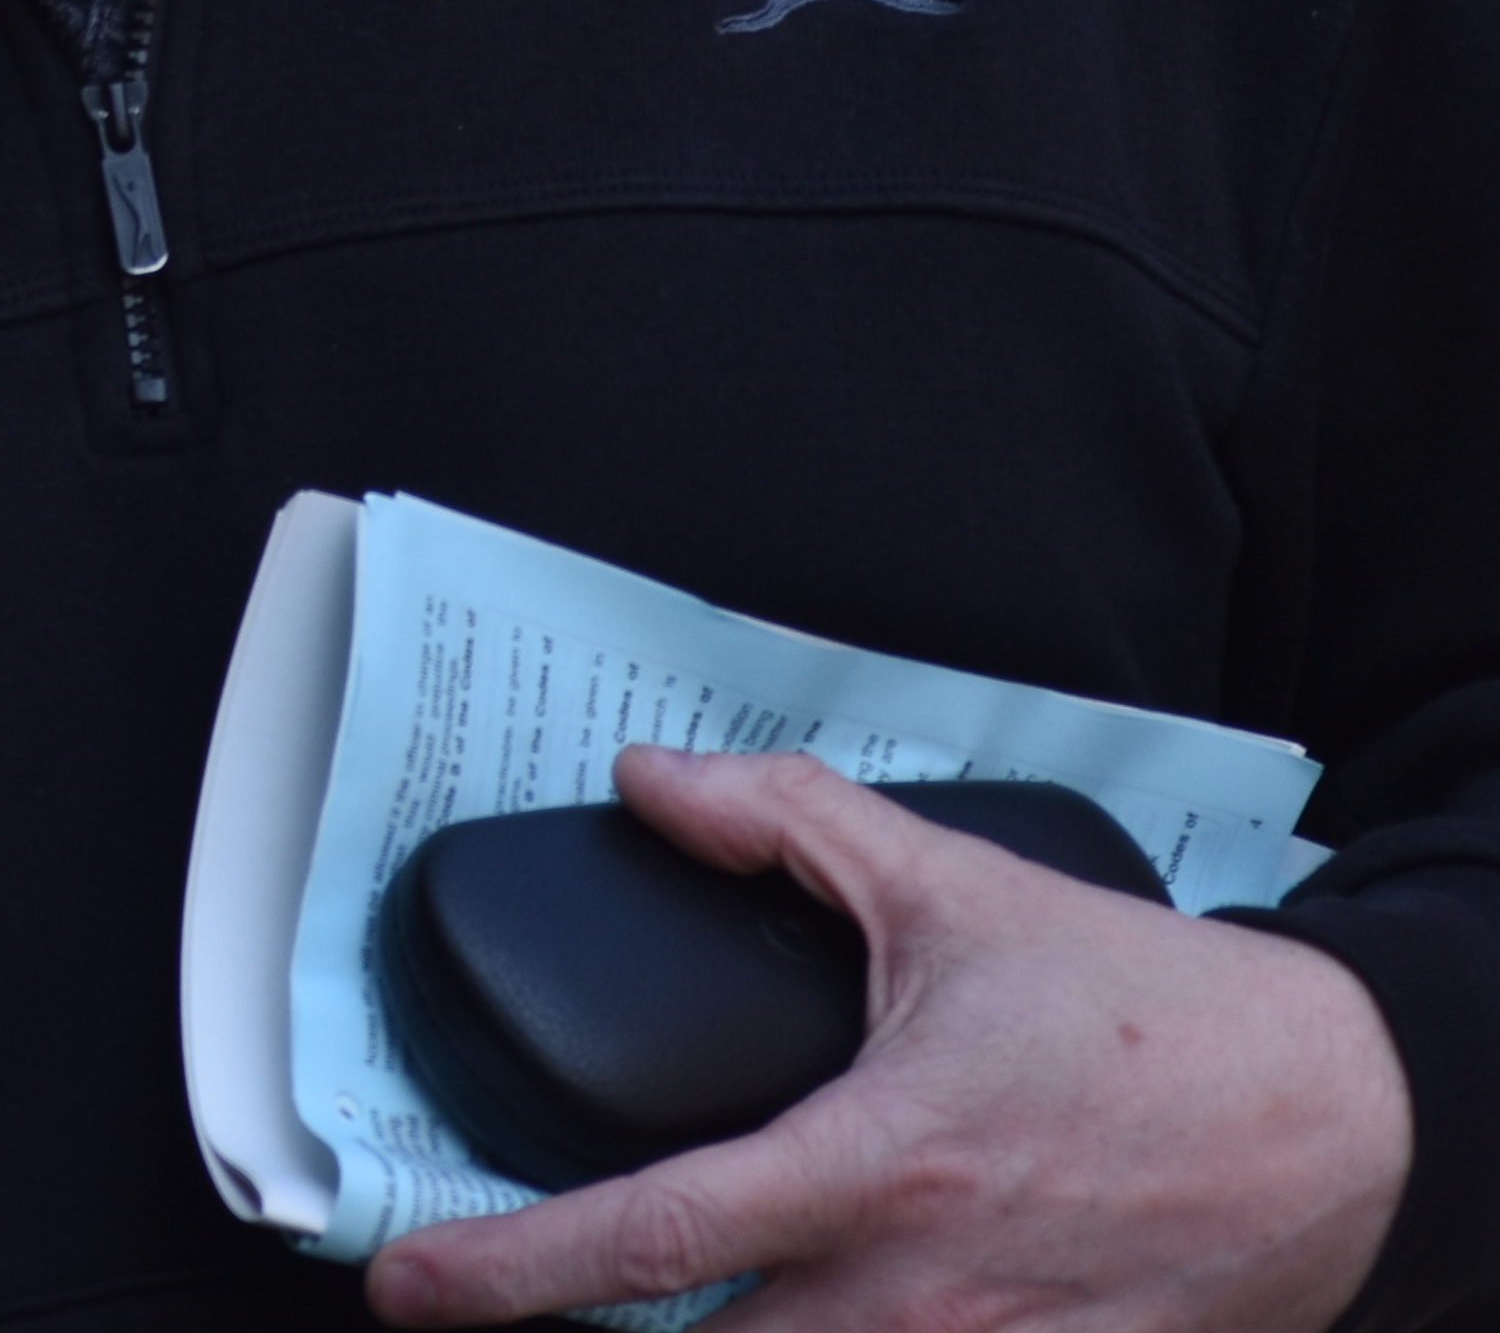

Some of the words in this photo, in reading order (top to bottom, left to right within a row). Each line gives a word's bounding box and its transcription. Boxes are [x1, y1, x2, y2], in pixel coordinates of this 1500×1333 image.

[422, 621, 431, 637] of
[436, 601, 448, 626] the
[466, 610, 476, 627] of
[543, 636, 553, 654] of
[416, 643, 431, 699] charge
[460, 637, 475, 692] Codes
[509, 647, 521, 692] given
[534, 664, 550, 719] Codes
[584, 675, 600, 720] given
[613, 689, 633, 744] Codes
[627, 661, 639, 680] of
[700, 685, 715, 703] of
[458, 701, 469, 727] the
[531, 727, 542, 753] the
[1163, 834, 1190, 887] Codes
[1186, 812, 1198, 829] of
